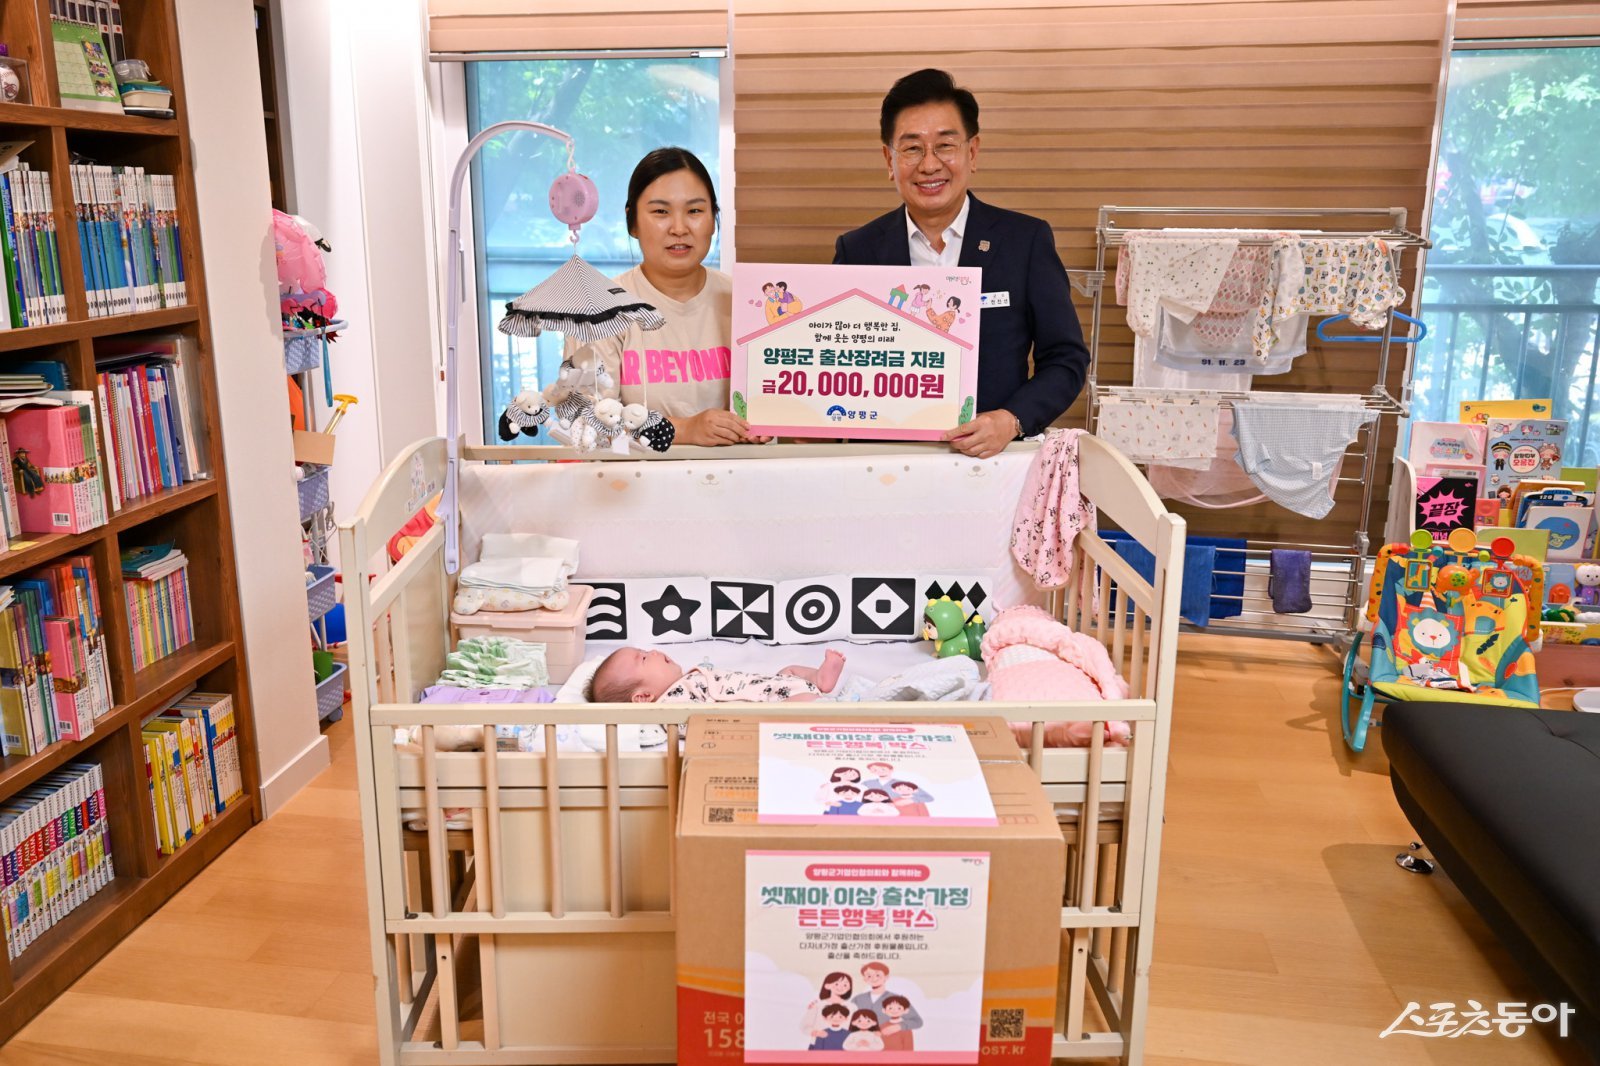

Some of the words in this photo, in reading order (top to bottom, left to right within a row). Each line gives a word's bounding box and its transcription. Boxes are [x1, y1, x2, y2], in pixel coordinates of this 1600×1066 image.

[808, 322, 832, 330] 아이가
[834, 320, 850, 330] 많아
[863, 322, 888, 332] 행복한
[814, 334, 832, 343] 함께
[834, 334, 850, 344] 웃는
[851, 334, 875, 344] 양평의
[878, 335, 896, 344] 미래
[644, 345, 731, 384] BEYOND
[763, 348, 814, 366] 양평군
[819, 348, 905, 368] 출산장려금
[910, 350, 946, 369] 지원
[1429, 502, 1460, 518] 끝장
[760, 886, 830, 906] 셋째아
[834, 886, 878, 906] 이상
[882, 886, 970, 907] 출산가정
[798, 908, 886, 928] 든든행복
[892, 908, 935, 928] 박스
[704, 1011, 730, 1025] 전국
